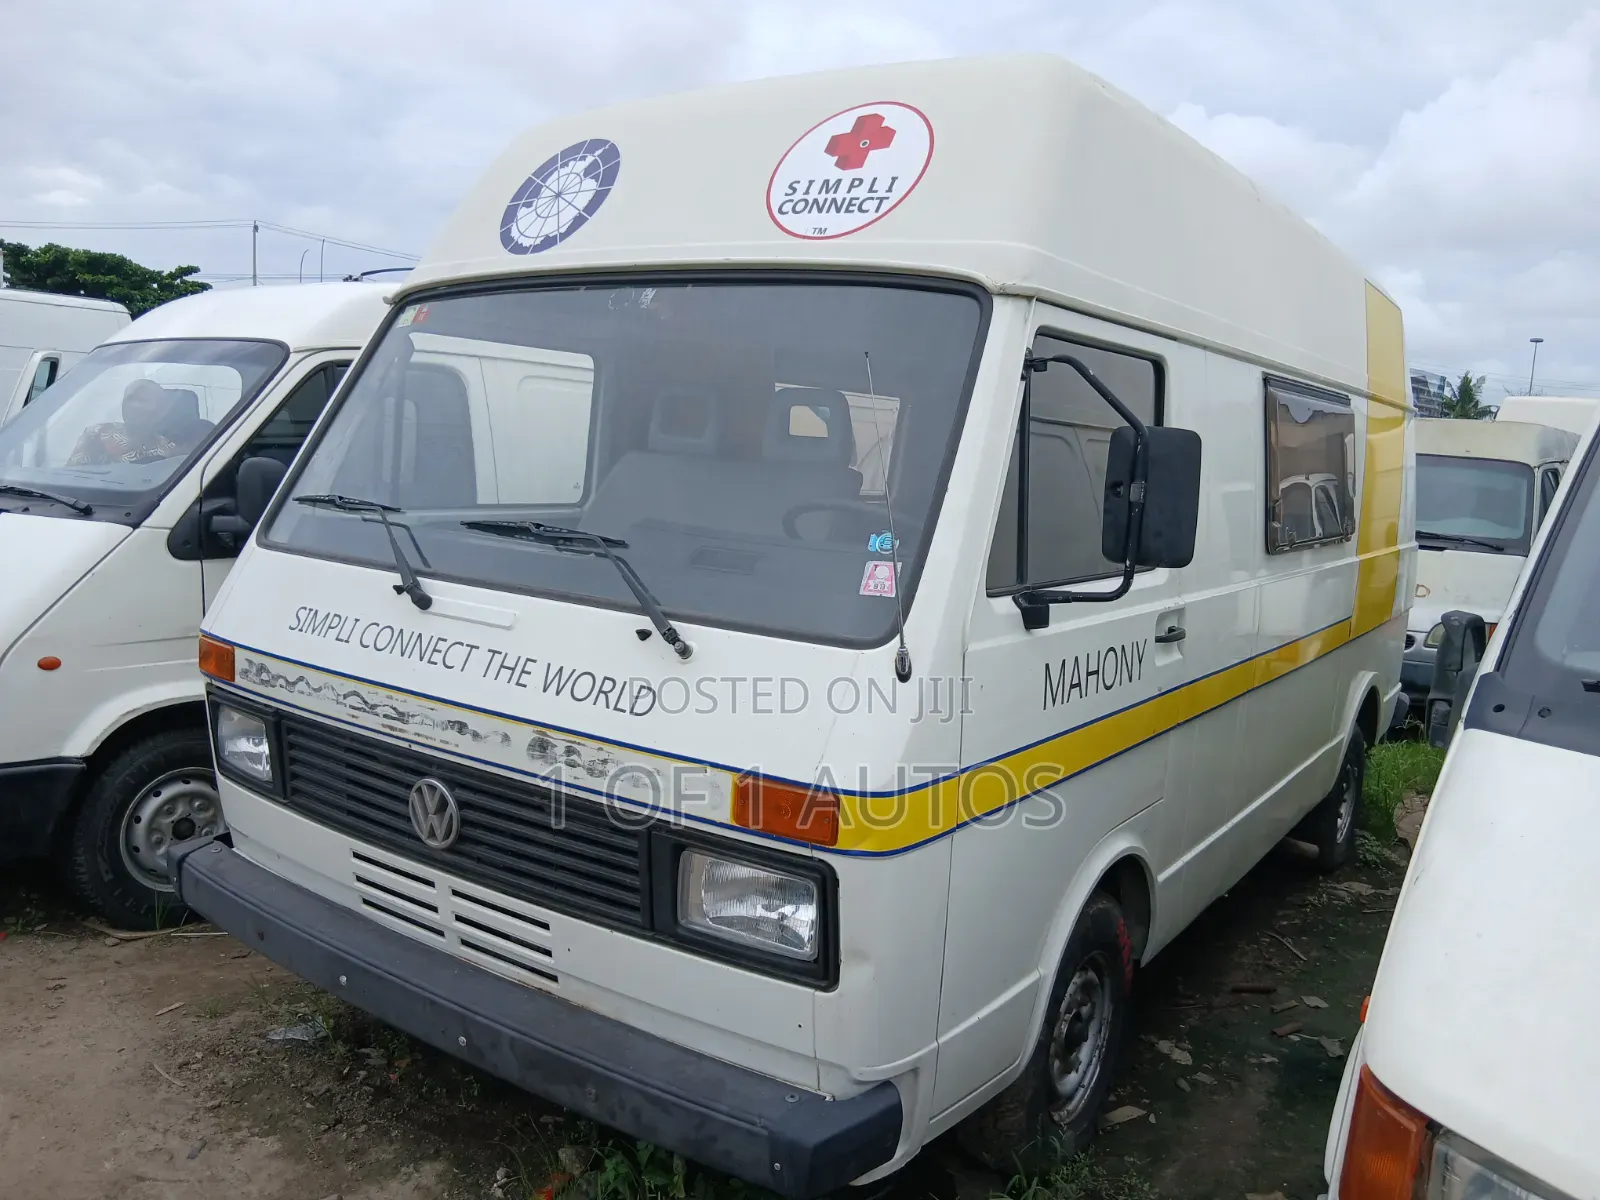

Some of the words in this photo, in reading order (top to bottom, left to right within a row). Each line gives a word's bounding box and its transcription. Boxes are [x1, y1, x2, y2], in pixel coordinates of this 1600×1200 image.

[778, 197, 889, 215] CONNECT
[784, 176, 898, 196] SIMPLI
[288, 606, 359, 643] SIMPLI
[359, 622, 480, 671] CONNECT
[481, 648, 538, 689] THE
[541, 664, 657, 716] WORLD
[1043, 639, 1148, 711] MAHONY
